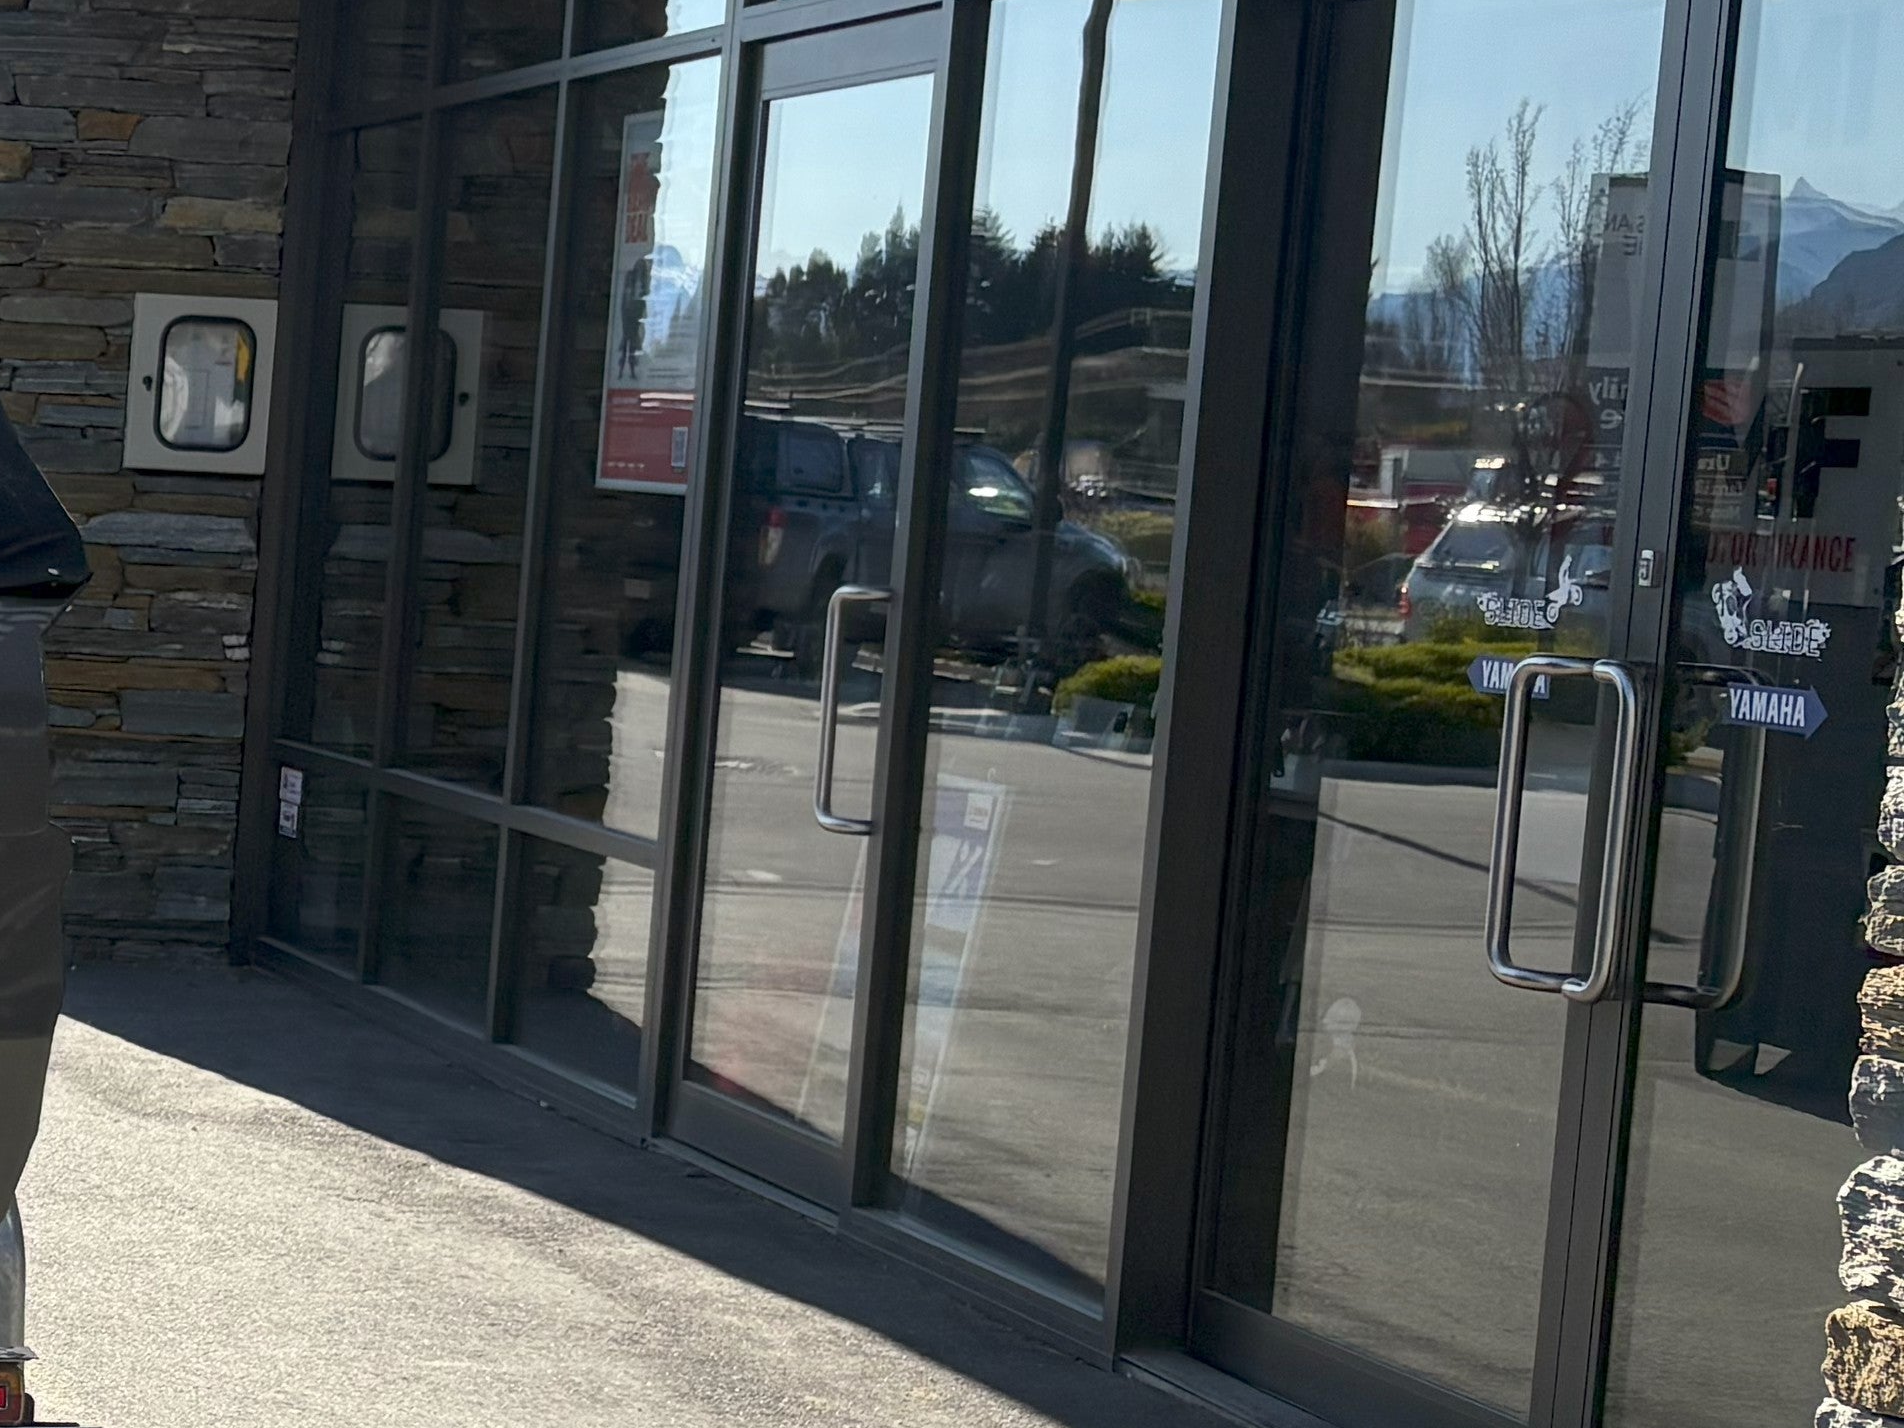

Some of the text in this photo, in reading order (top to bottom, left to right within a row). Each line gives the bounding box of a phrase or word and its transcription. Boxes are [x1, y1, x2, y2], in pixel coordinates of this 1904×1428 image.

[1750, 619, 1822, 658] SLIDE
[1482, 659, 1546, 694] YAMA
[1729, 687, 1806, 728] YAMAHA
